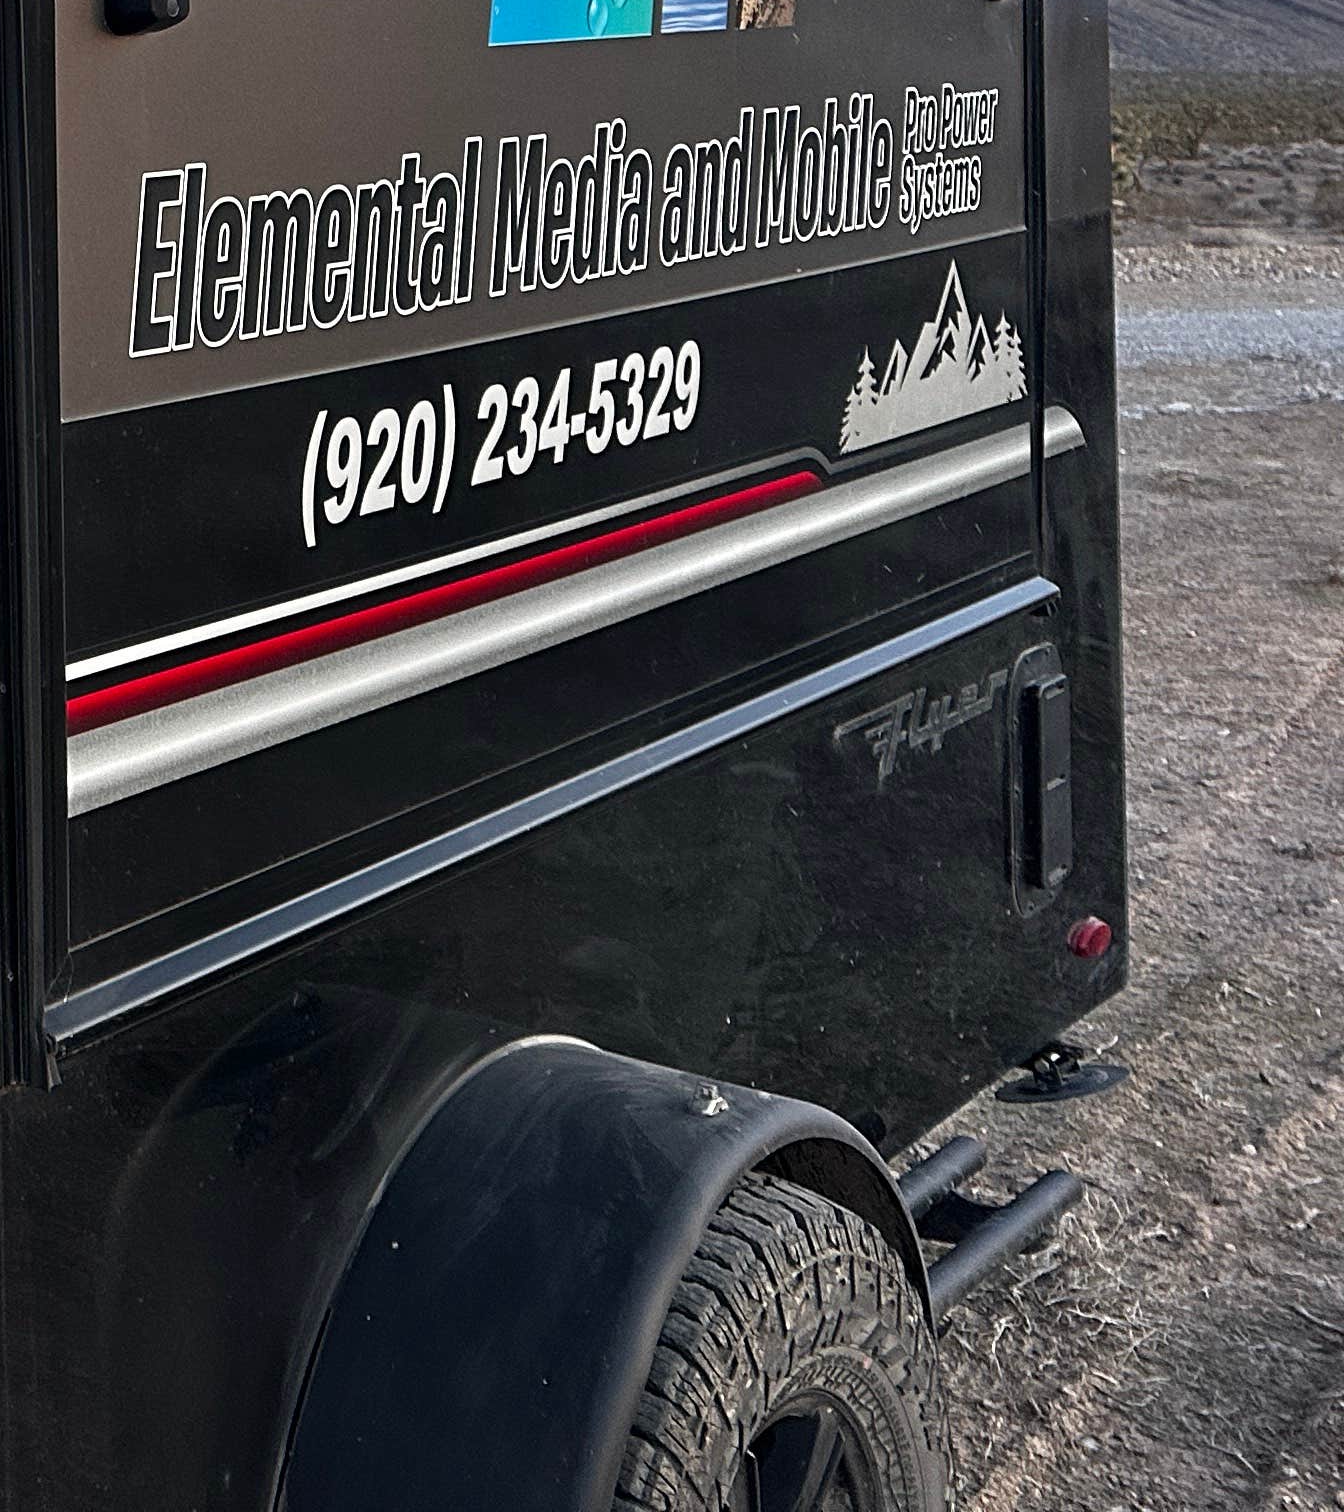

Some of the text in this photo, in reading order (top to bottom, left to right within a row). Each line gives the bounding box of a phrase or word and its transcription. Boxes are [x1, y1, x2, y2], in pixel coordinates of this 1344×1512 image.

[902, 82, 999, 155] Pro Power
[129, 92, 893, 358] Elemental Media and Mobile
[898, 152, 982, 235] Systems
[302, 340, 701, 548] (920) 234-5329
